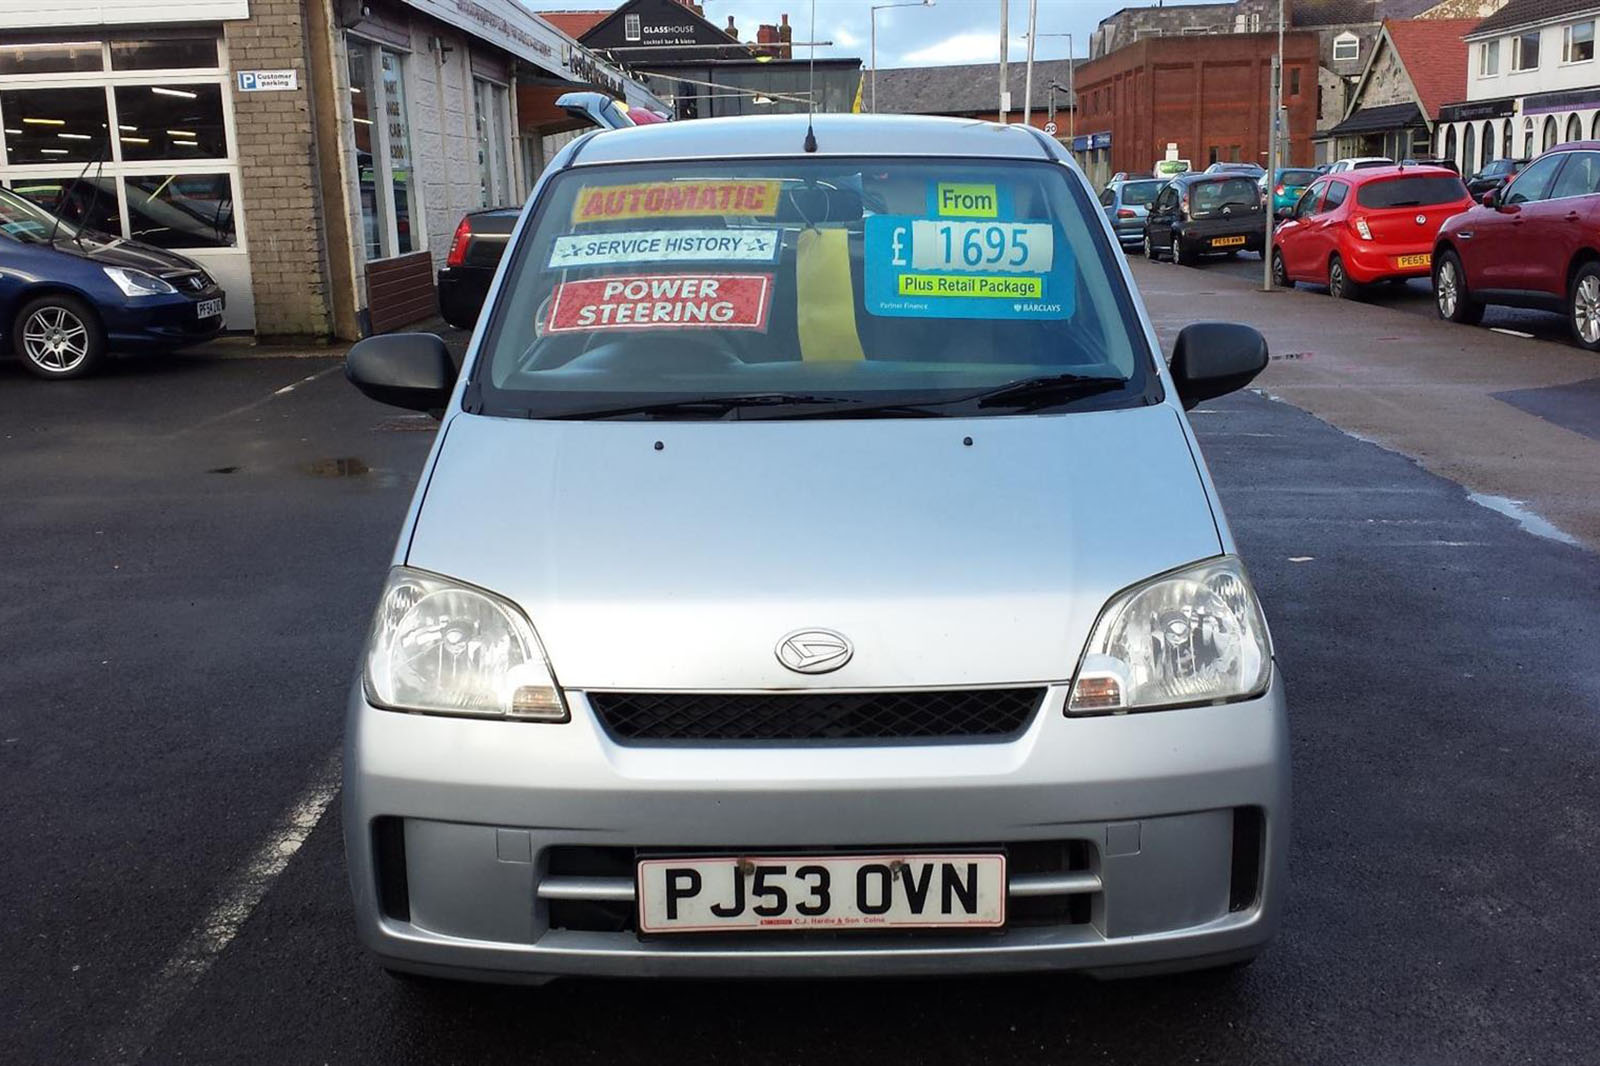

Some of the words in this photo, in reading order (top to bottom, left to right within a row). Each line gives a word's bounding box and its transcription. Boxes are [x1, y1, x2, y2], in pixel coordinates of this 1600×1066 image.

[643, 25, 694, 33] GLASSHOUSE
[242, 73, 254, 88] P
[581, 184, 766, 216] AUTOMATIC
[942, 189, 993, 210] From
[585, 239, 662, 256] SERVICE
[665, 237, 744, 252] HISTORY
[891, 226, 907, 266] £
[940, 226, 1029, 266] 1695
[1401, 255, 1425, 266] PE65
[603, 279, 720, 301] POWER
[904, 277, 934, 291] Plus
[938, 278, 975, 292] Retail
[980, 280, 1036, 295] Package
[577, 302, 735, 326] STEERING
[880, 302, 903, 311] Partner
[904, 302, 929, 311] Finance
[1022, 304, 1061, 313] BARCLAYS
[665, 864, 831, 920] PJ53
[856, 863, 978, 915] OVN
[837, 917, 844, 925] &
